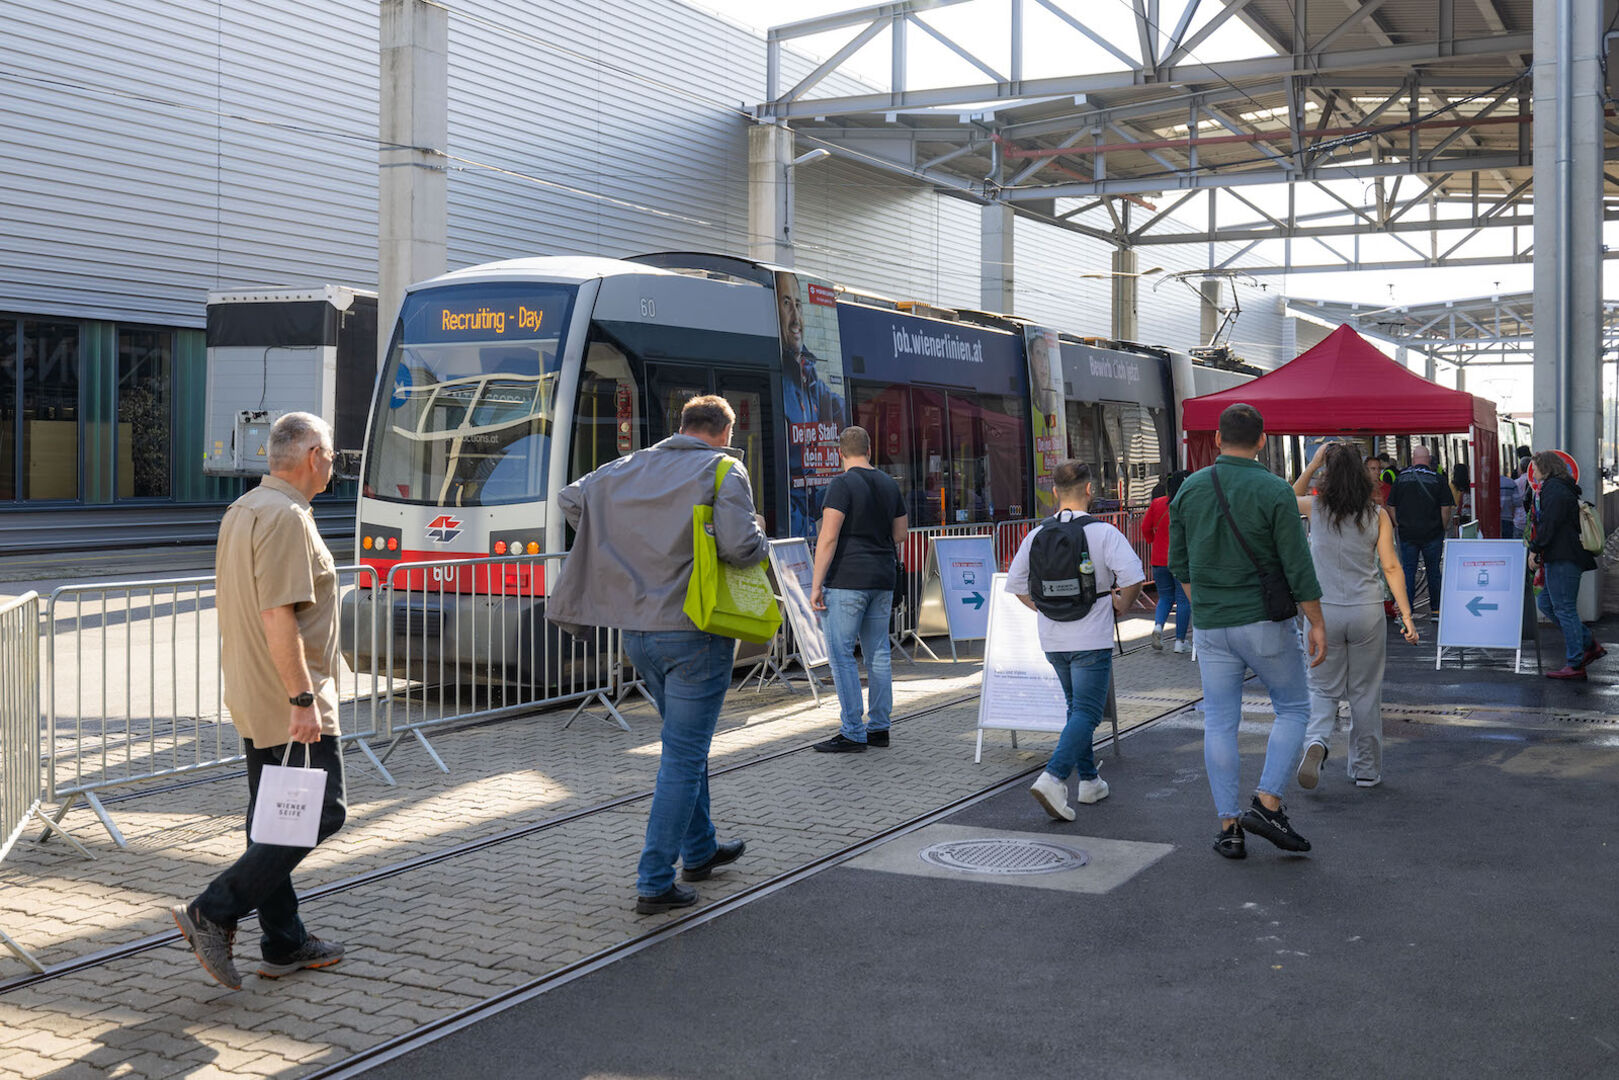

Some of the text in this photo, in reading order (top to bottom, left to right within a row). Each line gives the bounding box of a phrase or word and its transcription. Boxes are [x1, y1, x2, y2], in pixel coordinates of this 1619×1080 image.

[641, 298, 656, 317] 60
[442, 308, 505, 333] Recruiting
[518, 306, 543, 332] Day
[892, 325, 983, 363] job.wienerlinien.at
[792, 425, 816, 443] Deine
[803, 448, 840, 467] dein Job
[276, 802, 306, 811] WIENER
